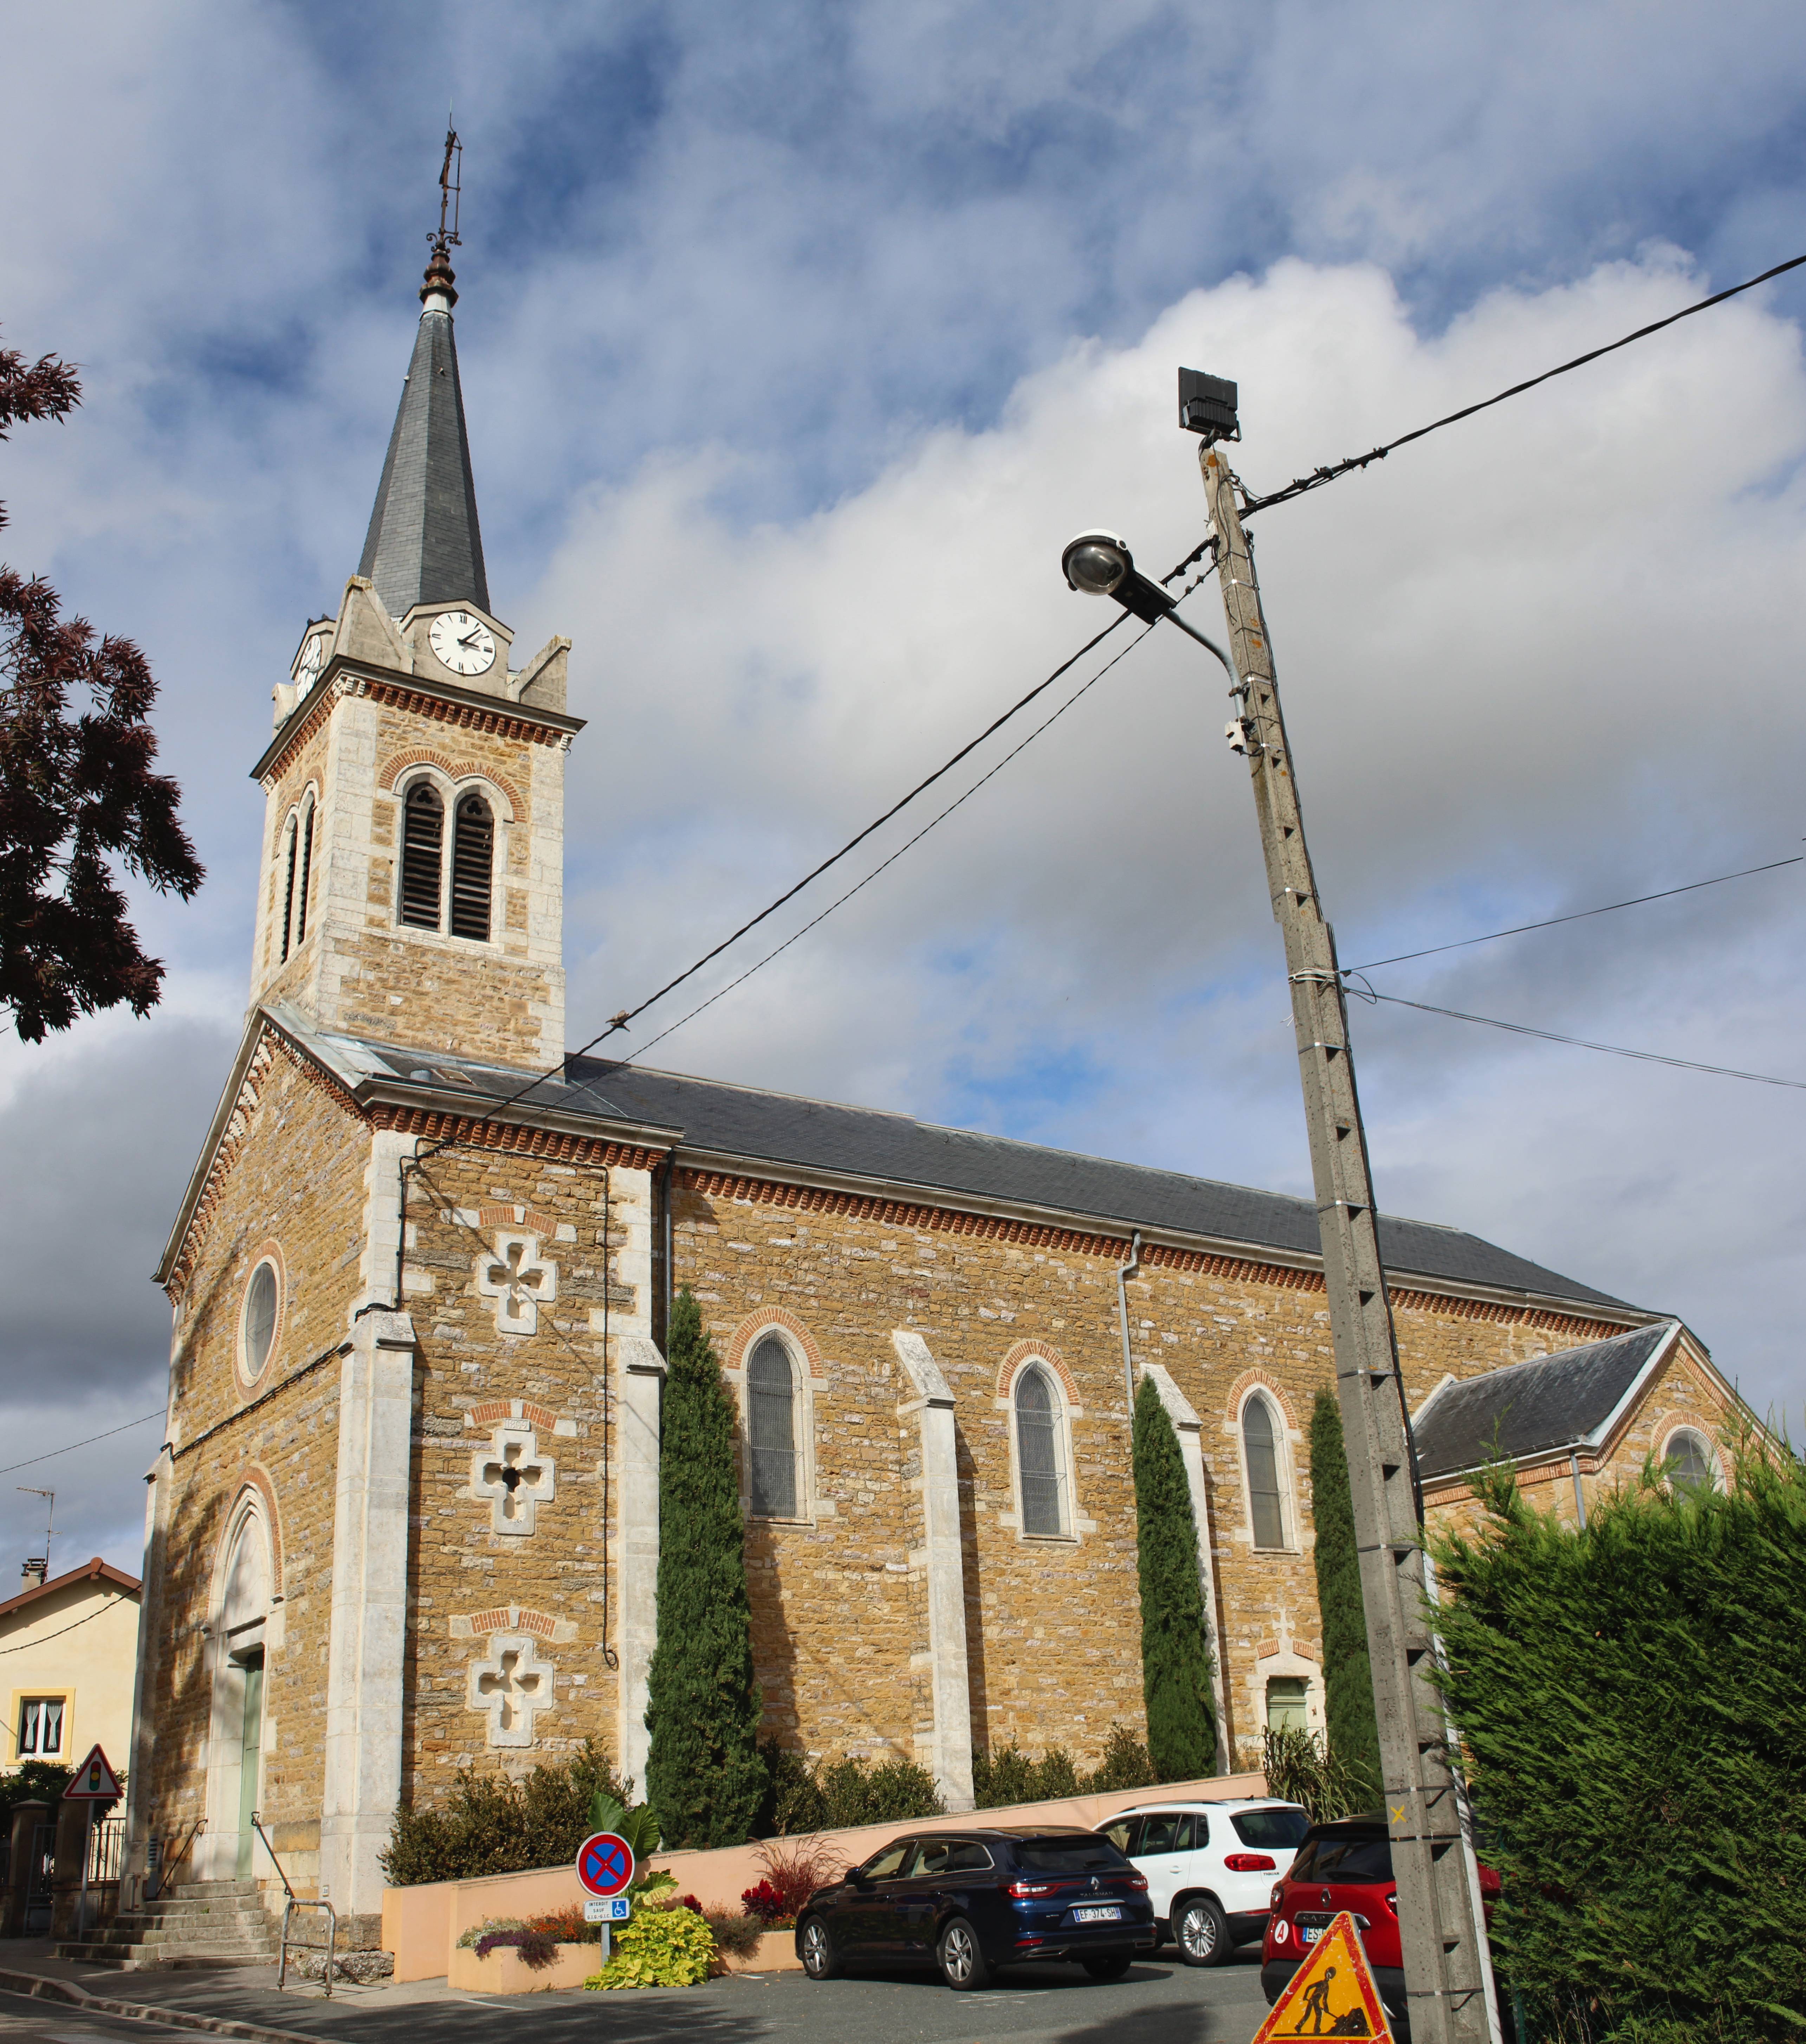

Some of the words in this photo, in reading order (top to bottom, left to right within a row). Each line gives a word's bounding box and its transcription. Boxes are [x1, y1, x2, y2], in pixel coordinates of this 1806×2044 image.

[459, 614, 467, 624] XII
[1079, 1908, 1116, 1919] EF-374-SH
[1277, 1923, 1284, 1940] A
